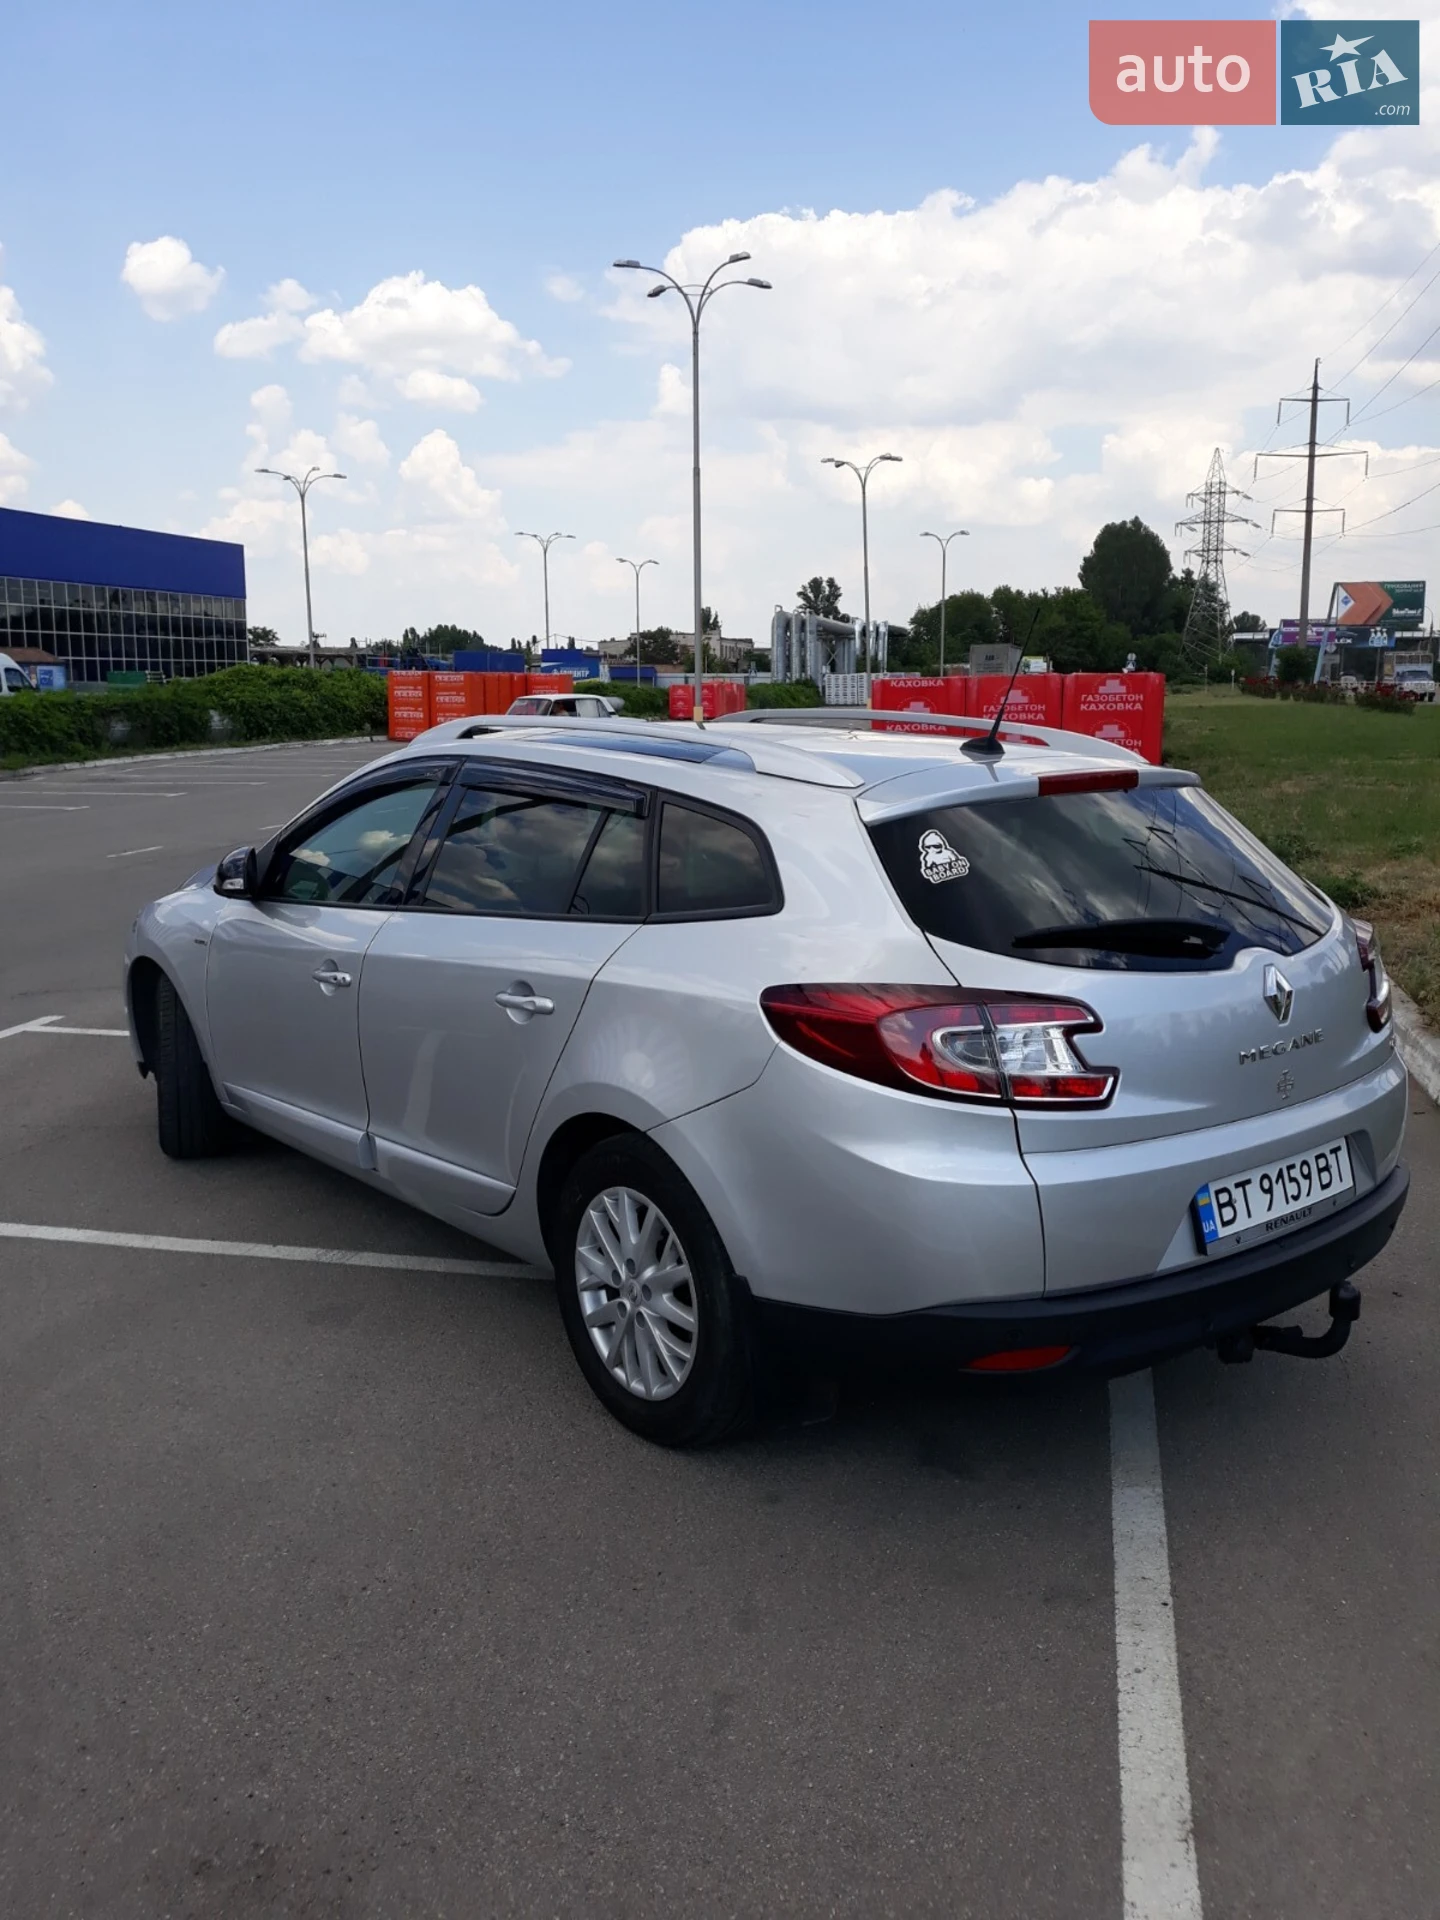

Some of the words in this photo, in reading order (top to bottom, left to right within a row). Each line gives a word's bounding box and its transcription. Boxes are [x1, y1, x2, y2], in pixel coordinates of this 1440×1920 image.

[890, 679, 944, 688] КАХОВКА
[1080, 693, 1144, 702] ГАЗОБЕТОН
[1080, 702, 1143, 711] КАХОВКА
[925, 863, 950, 876] BABY
[951, 860, 967, 868] ON
[932, 867, 966, 881] BOARD
[1239, 1028, 1325, 1066] MEGANE
[1265, 1207, 1313, 1231] RENAULT
[1202, 1220, 1216, 1233] UA
